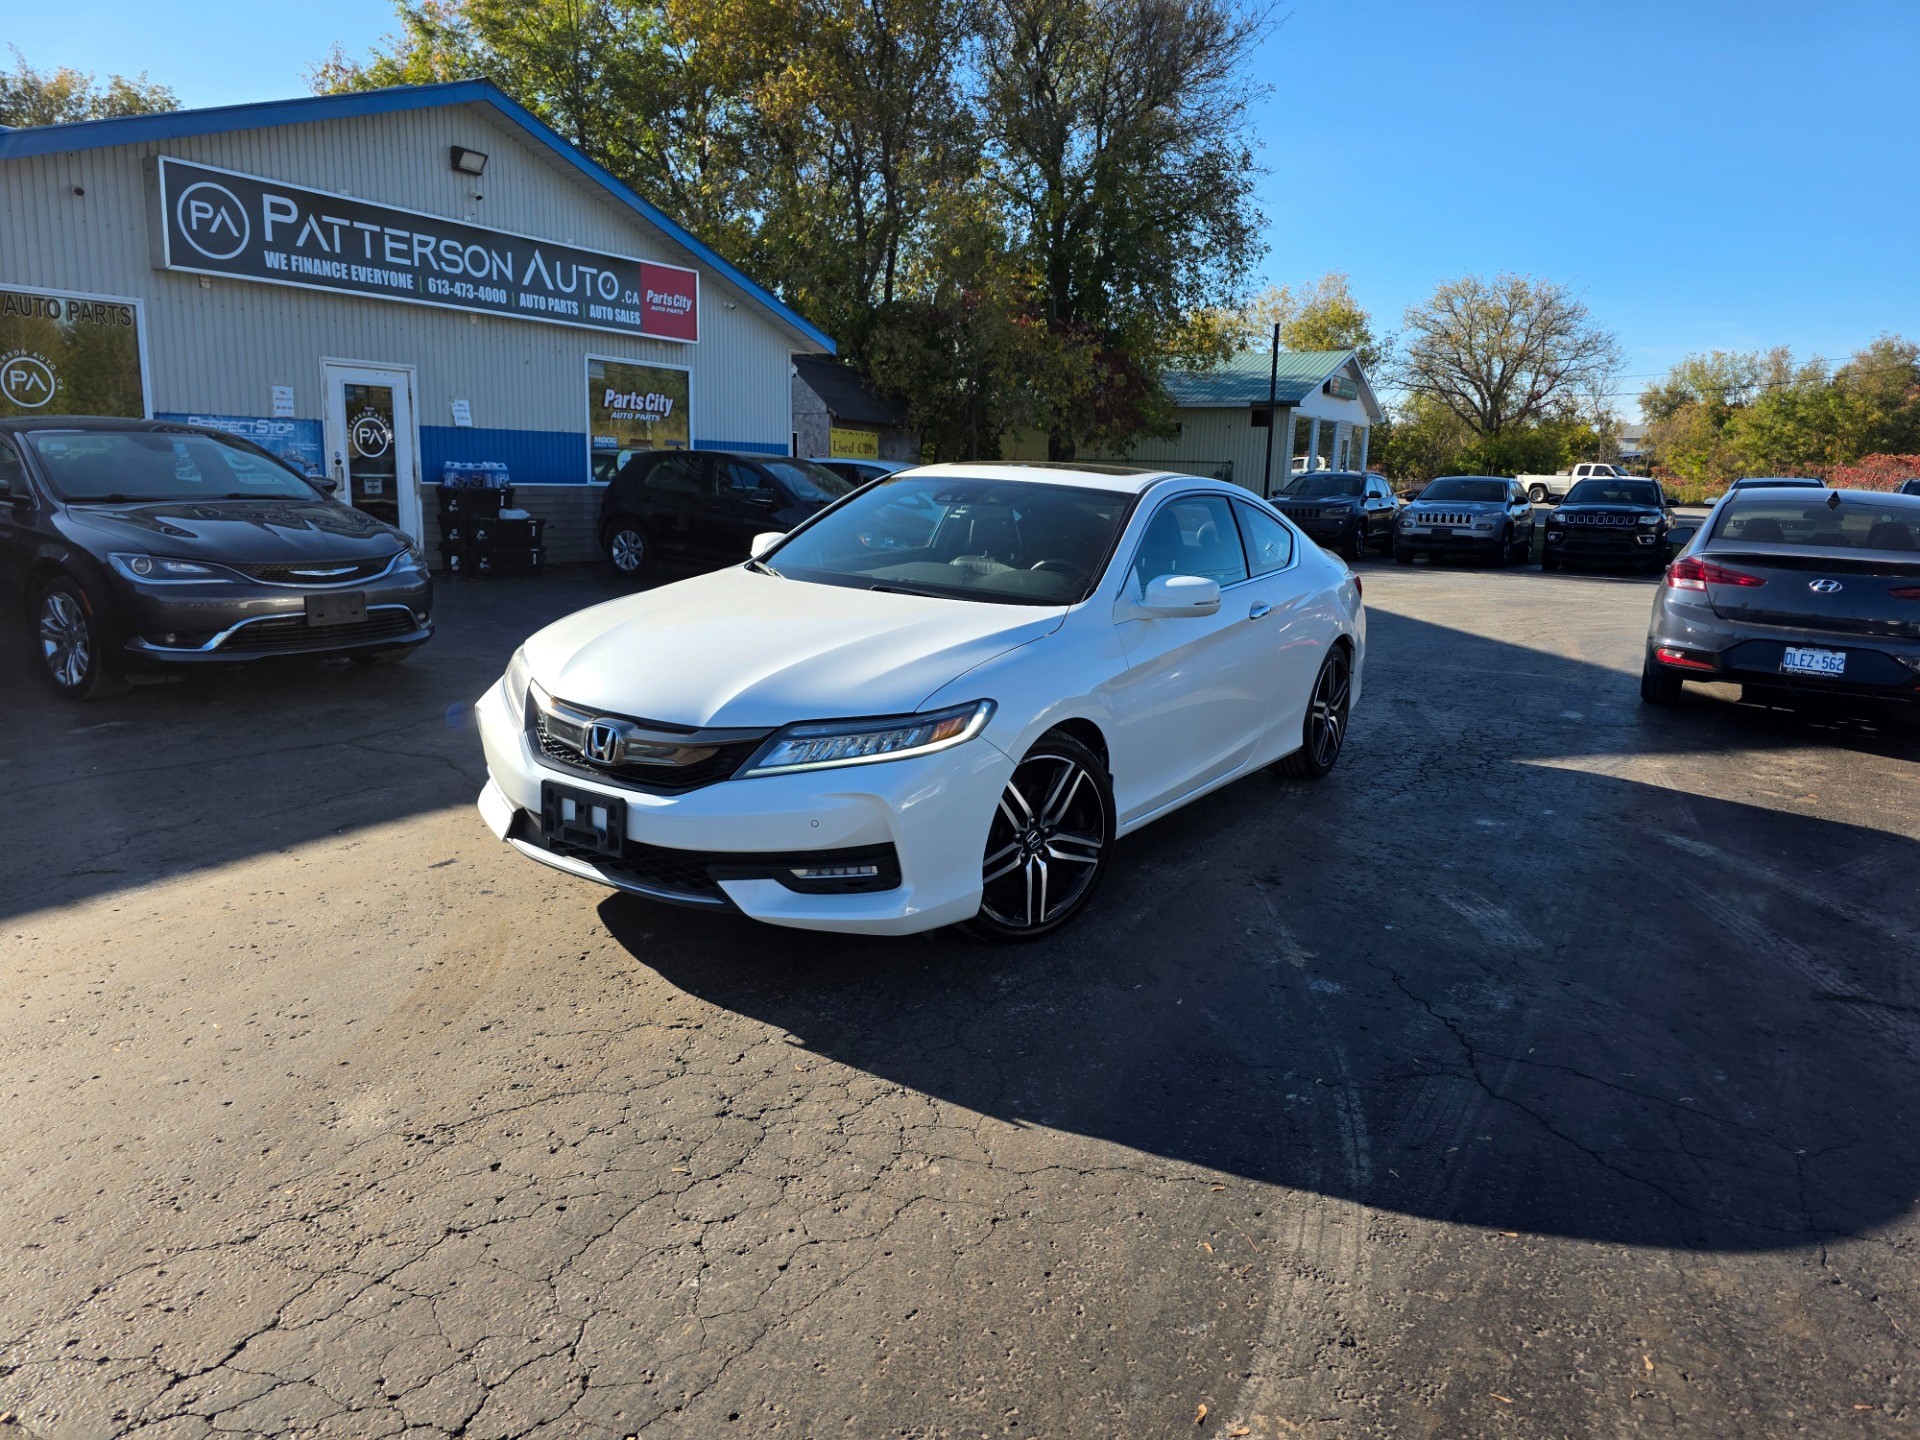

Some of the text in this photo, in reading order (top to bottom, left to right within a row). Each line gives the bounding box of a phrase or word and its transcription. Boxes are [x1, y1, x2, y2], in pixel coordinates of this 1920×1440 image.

[262, 193, 514, 283] PATTERSON
[264, 250, 414, 290] WE FINANCE EVERYONE
[427, 277, 507, 304] 613-473-4000
[3, 294, 133, 327] AUTO PARTS
[519, 292, 579, 316] AUTO PARTS
[589, 304, 641, 325] AUTO SALES
[666, 307, 684, 315] PARTS
[611, 411, 661, 422] AUTO PARTS
[833, 441, 854, 453] Used
[1785, 652, 1844, 671] DLEZ 562
